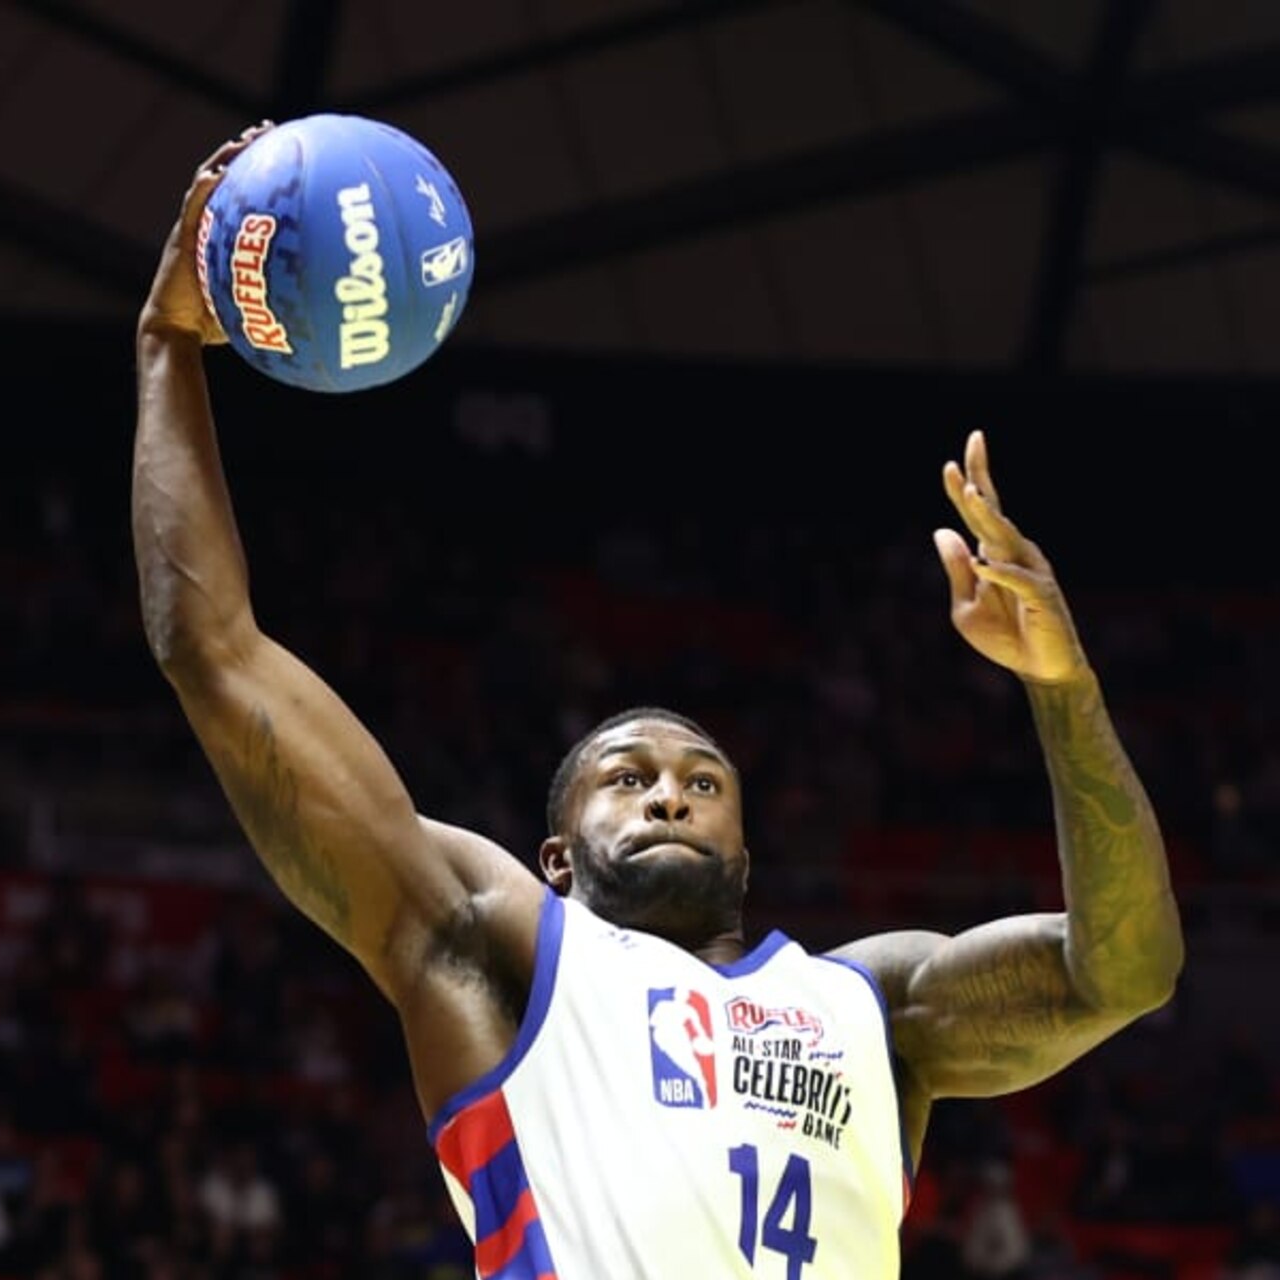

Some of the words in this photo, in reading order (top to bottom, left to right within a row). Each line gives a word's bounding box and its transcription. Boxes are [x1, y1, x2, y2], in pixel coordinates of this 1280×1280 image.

[232, 214, 292, 353] RUFFLES
[337, 184, 390, 369] Wilson
[661, 1079, 695, 1102] NBA
[802, 1113, 843, 1150] GAME
